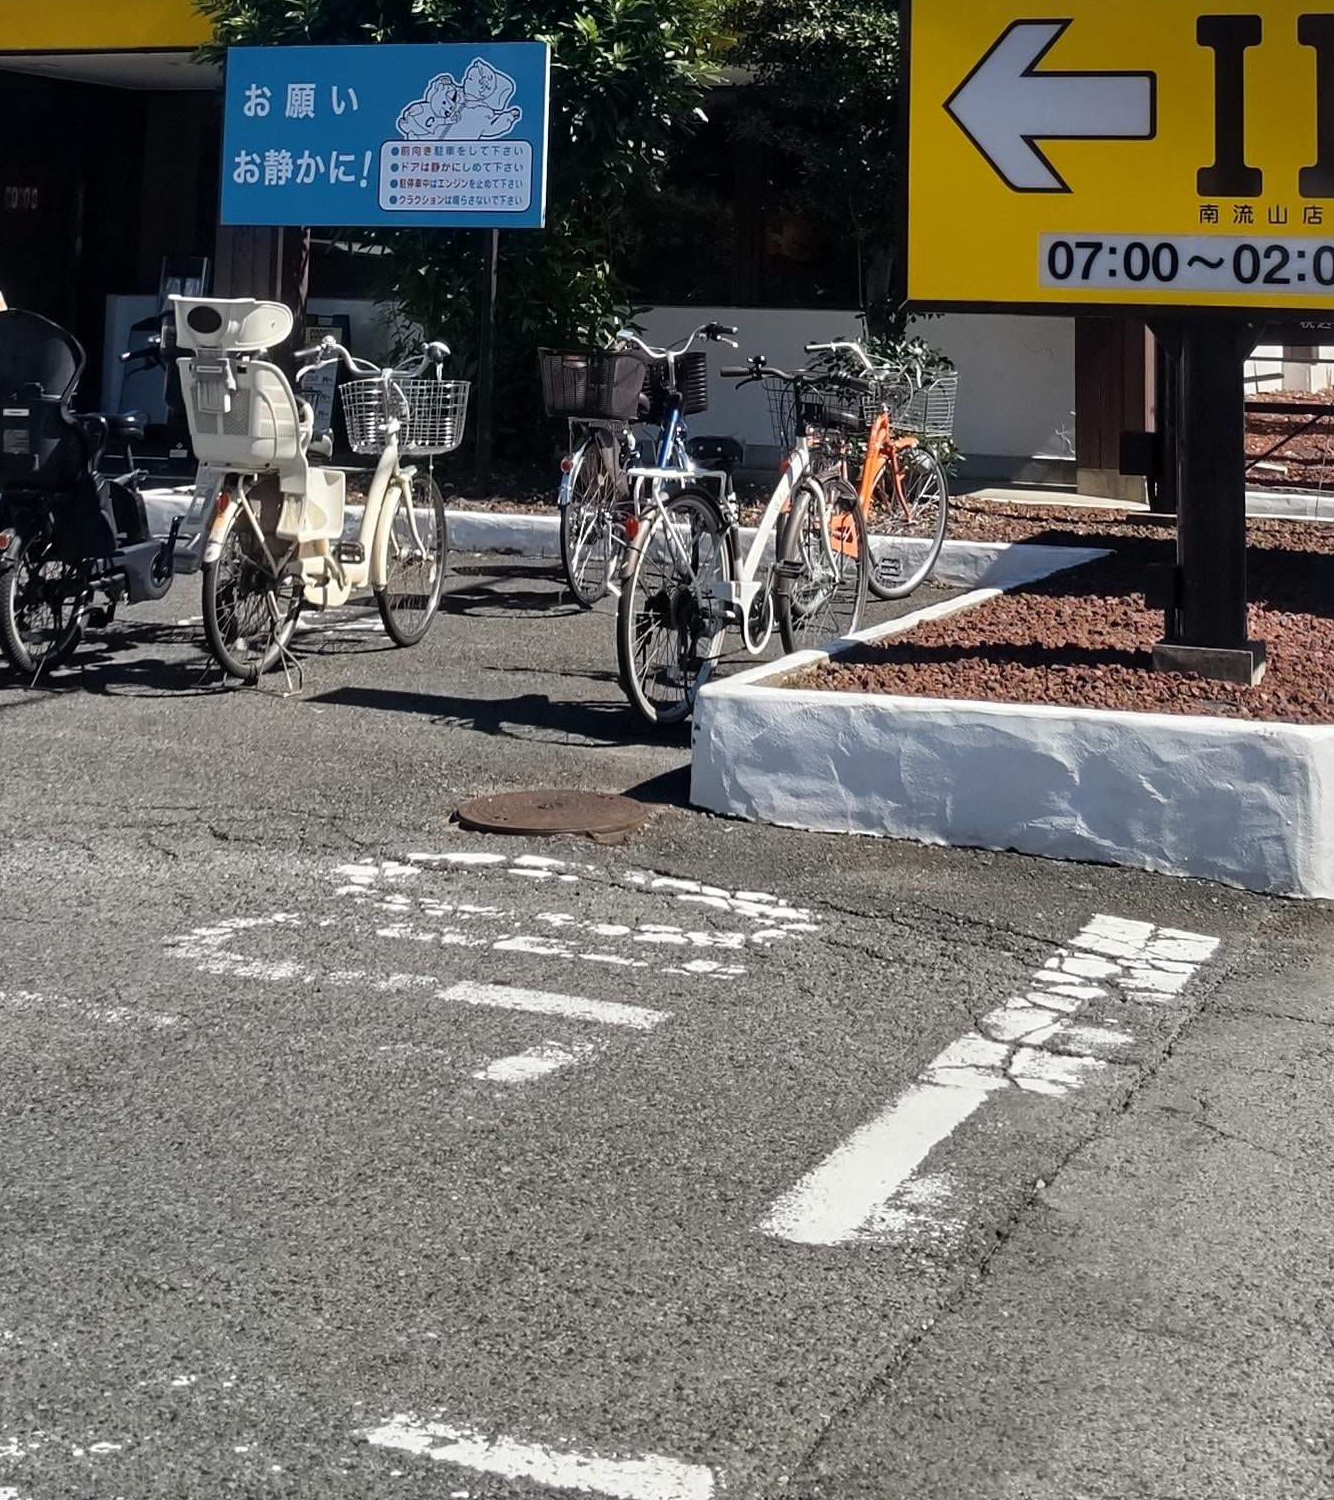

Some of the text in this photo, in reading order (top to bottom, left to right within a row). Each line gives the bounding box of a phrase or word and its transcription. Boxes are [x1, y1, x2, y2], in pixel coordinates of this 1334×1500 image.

[243, 83, 359, 119] お願い
[232, 149, 373, 188] お静かに!
[1199, 204, 1324, 226] 南流山店
